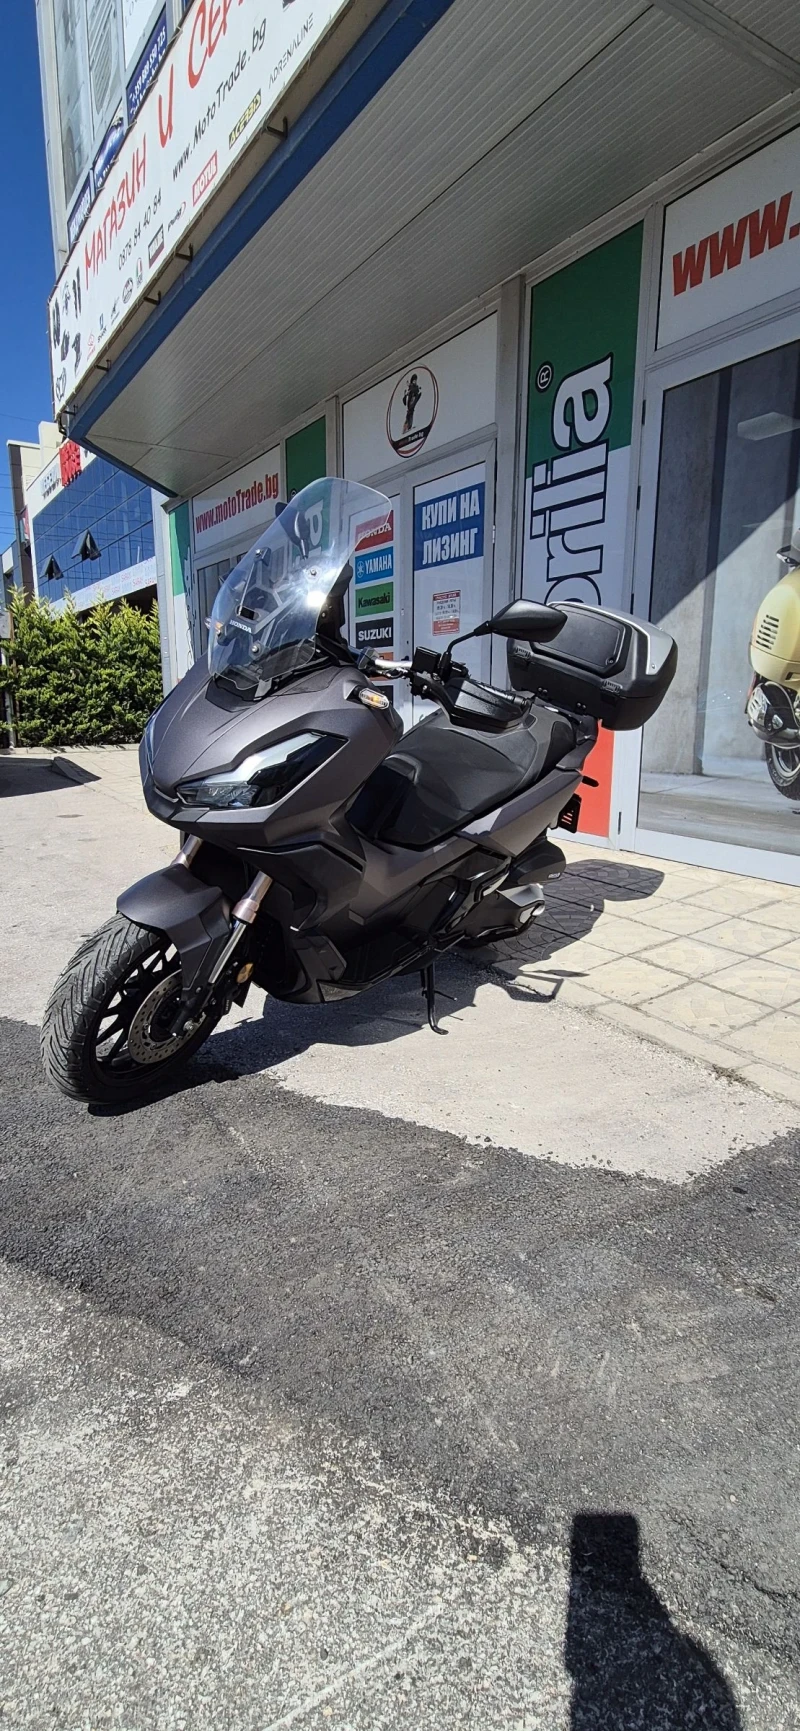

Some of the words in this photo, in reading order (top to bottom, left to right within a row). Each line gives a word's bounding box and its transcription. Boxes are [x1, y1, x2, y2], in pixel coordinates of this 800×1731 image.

[84, 132, 147, 290] МАГАЗИН
[153, 188, 161, 216] 84
[195, 472, 279, 534] www.motoTrade.bg
[421, 496, 457, 531] КУПИ
[460, 489, 480, 520] НА
[422, 527, 478, 566] ЛИЗИНГ
[364, 553, 393, 575] YAMAHA
[358, 591, 391, 610] Kawasaki
[229, 619, 252, 633] HONDA
[358, 625, 392, 642] SUZUKI
